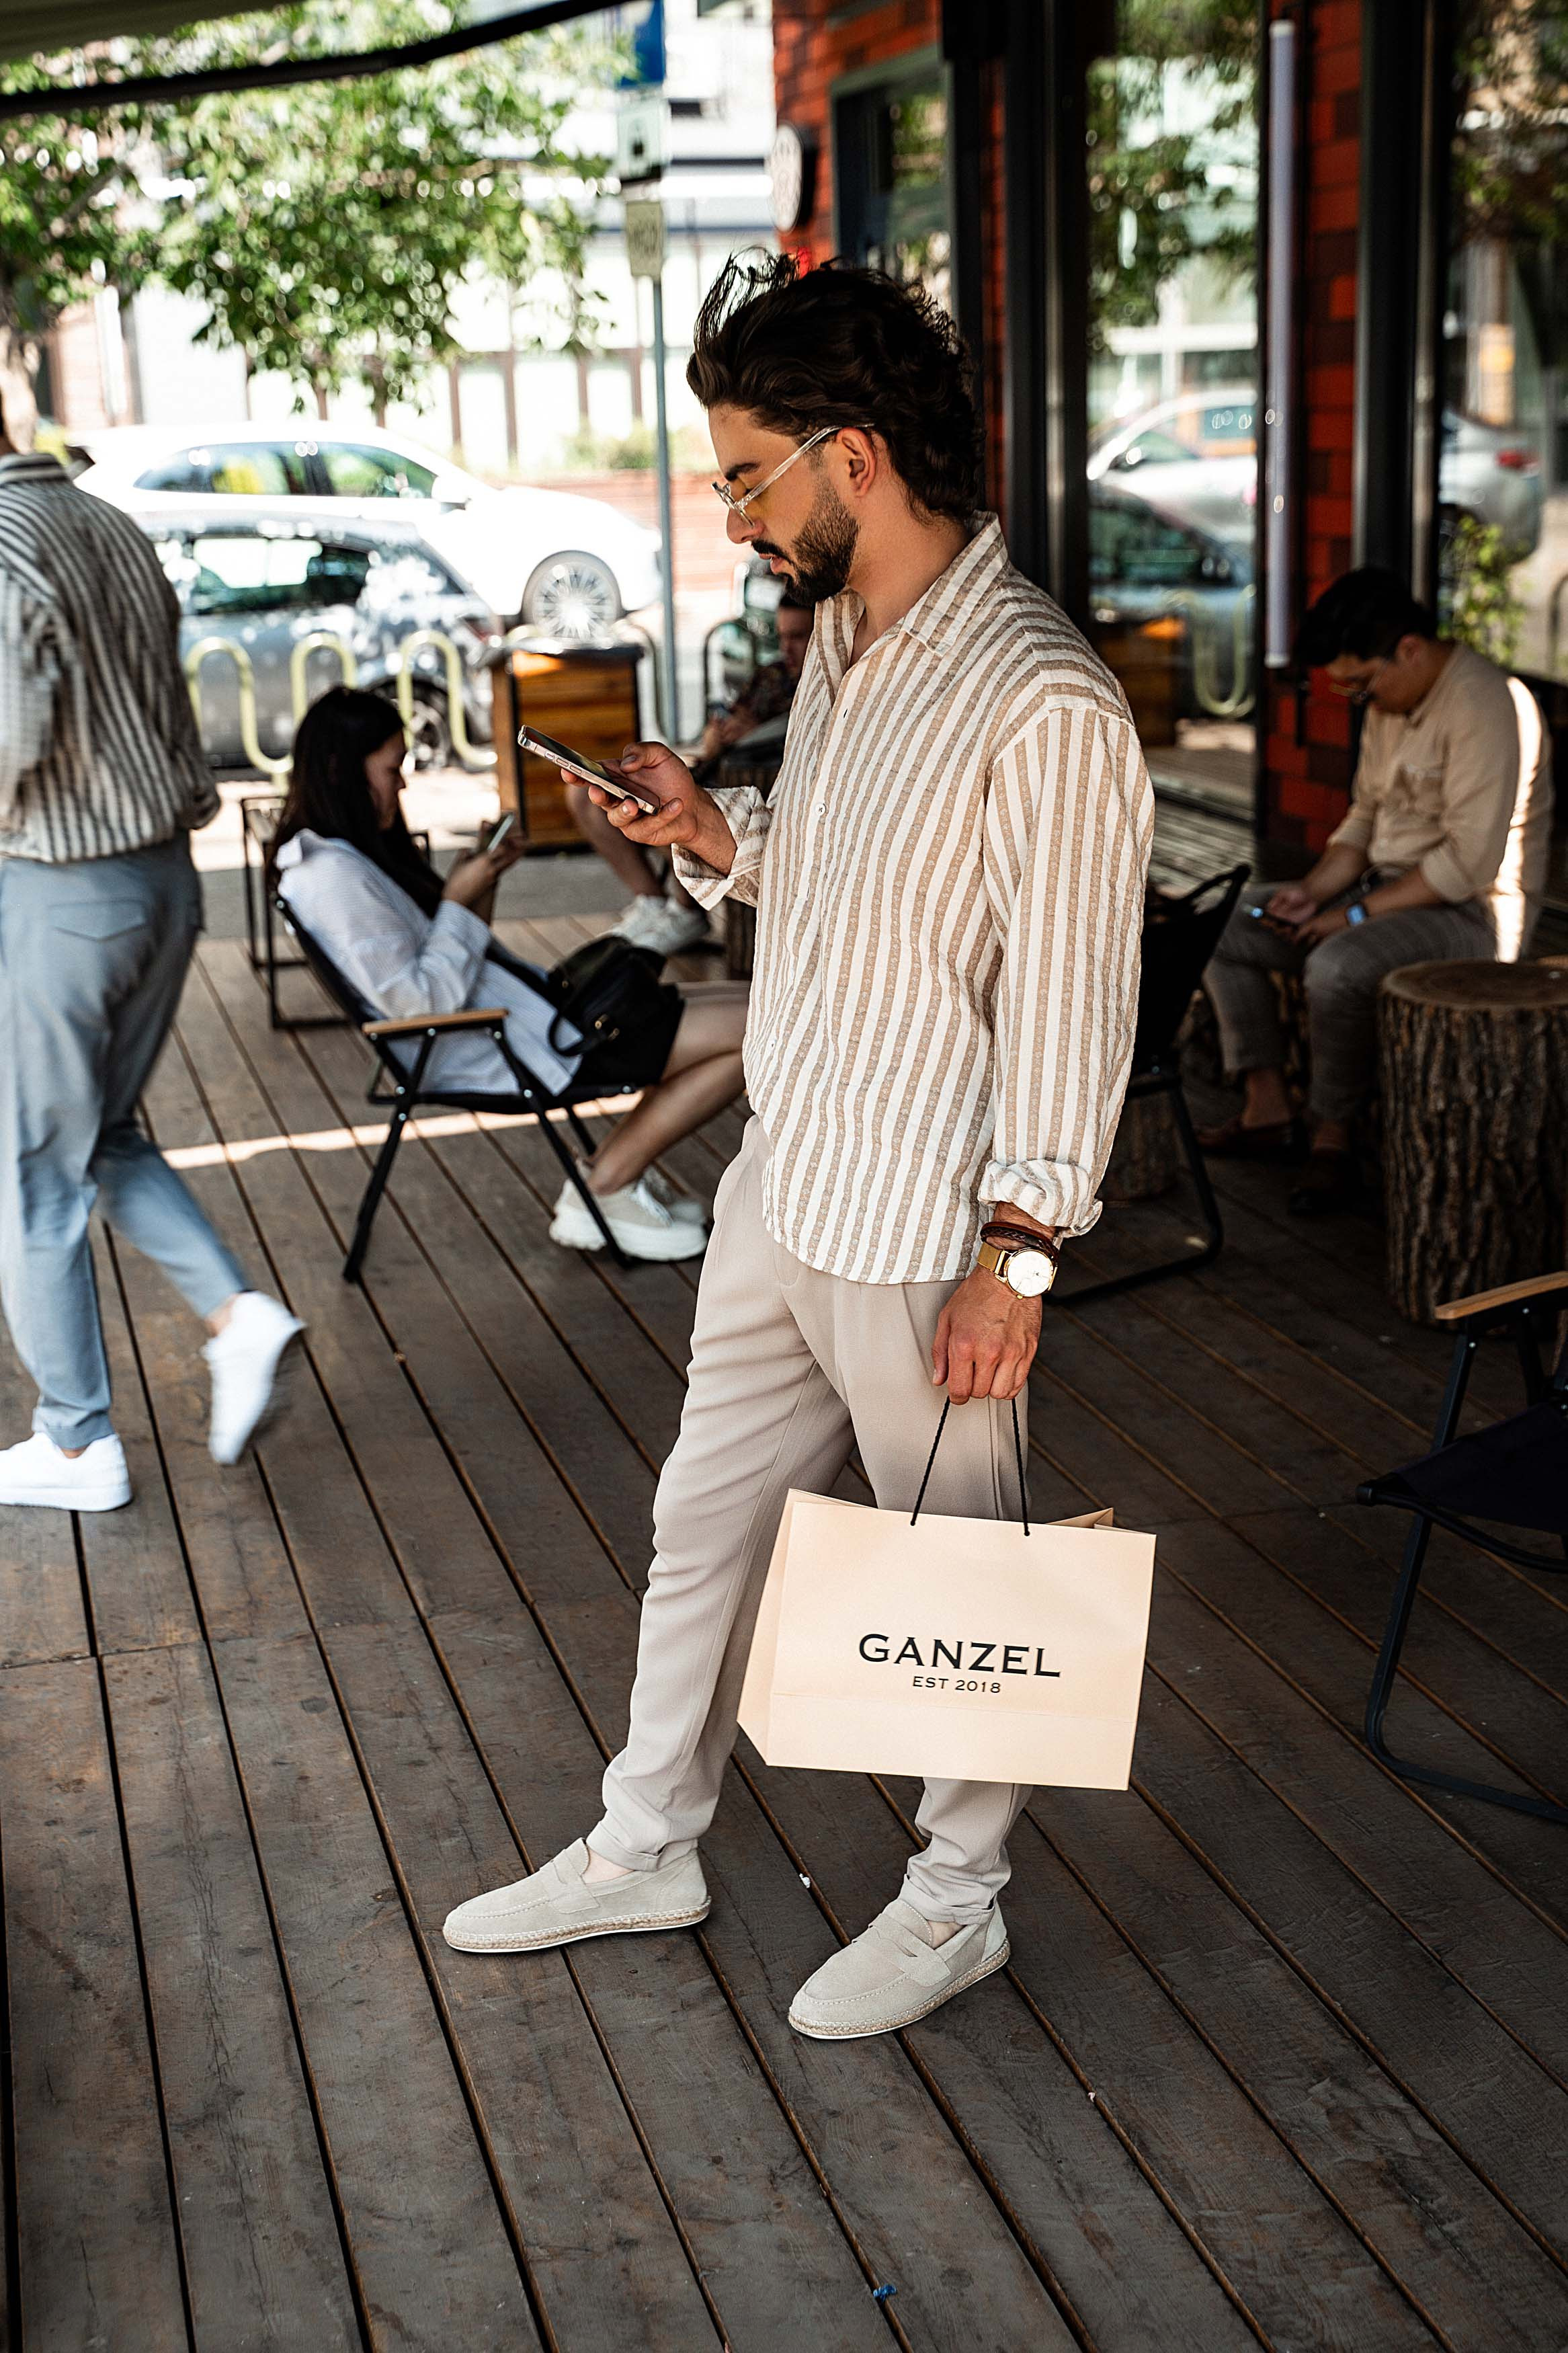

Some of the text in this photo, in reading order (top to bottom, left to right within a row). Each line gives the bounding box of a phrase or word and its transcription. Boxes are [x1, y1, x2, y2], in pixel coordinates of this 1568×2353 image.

[859, 1634, 1061, 1677] GANZEL
[912, 1675, 1001, 1693] EST 2018
